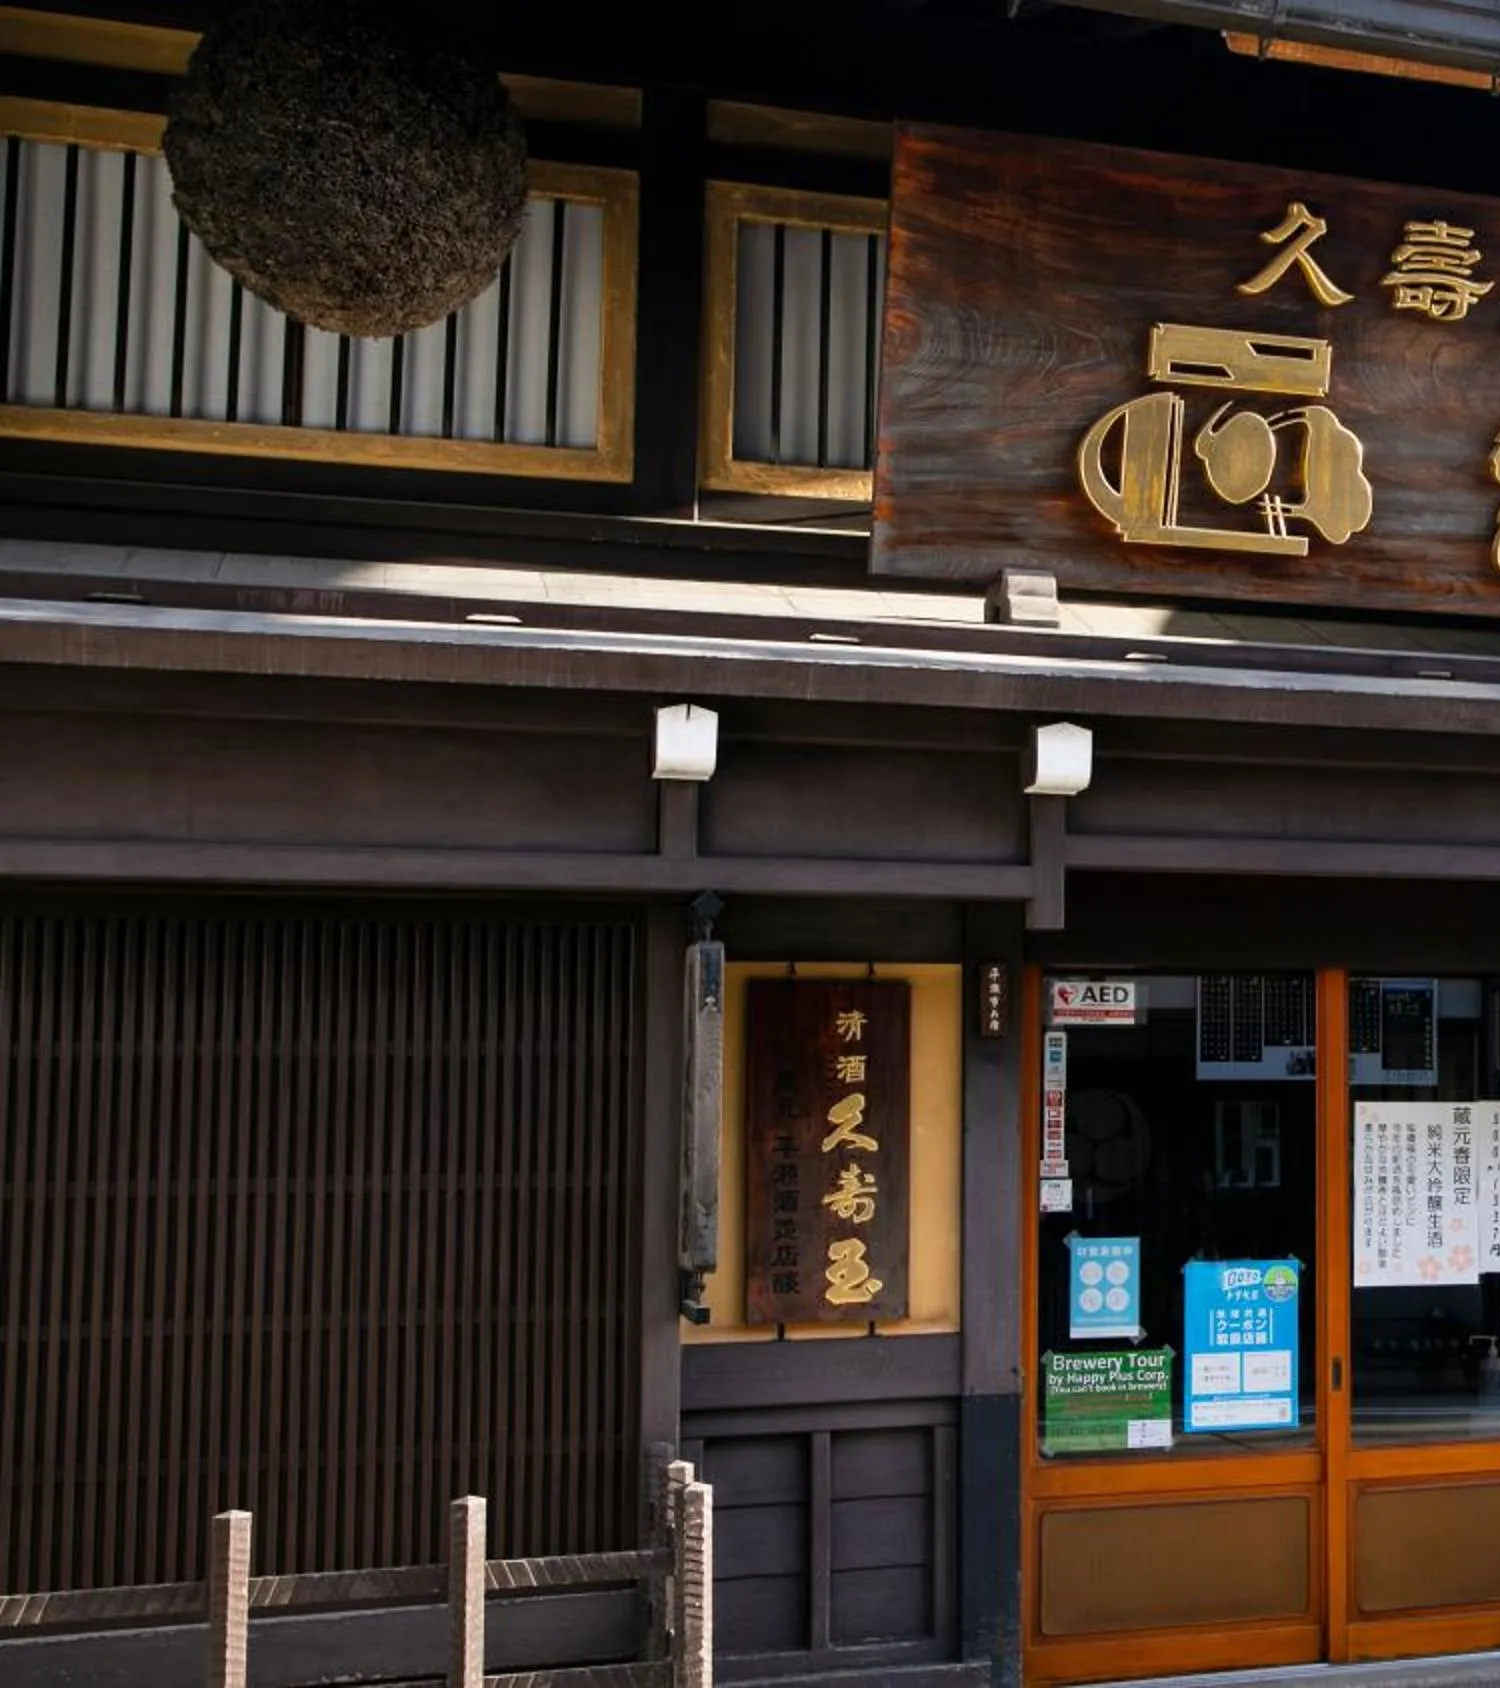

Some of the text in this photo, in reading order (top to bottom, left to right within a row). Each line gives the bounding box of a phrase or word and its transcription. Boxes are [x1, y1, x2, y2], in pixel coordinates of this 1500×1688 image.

[1081, 985, 1130, 1004] AED
[836, 1010, 869, 1084] 清酒
[1452, 1106, 1472, 1206] 蔵元春限定
[1427, 1125, 1443, 1249] 純米大吟醸生酒
[1216, 1318, 1267, 1331] クーポン
[1053, 1353, 1166, 1372] Brewery Tour
[1049, 1369, 1169, 1386] by Happy Plus Corp.
